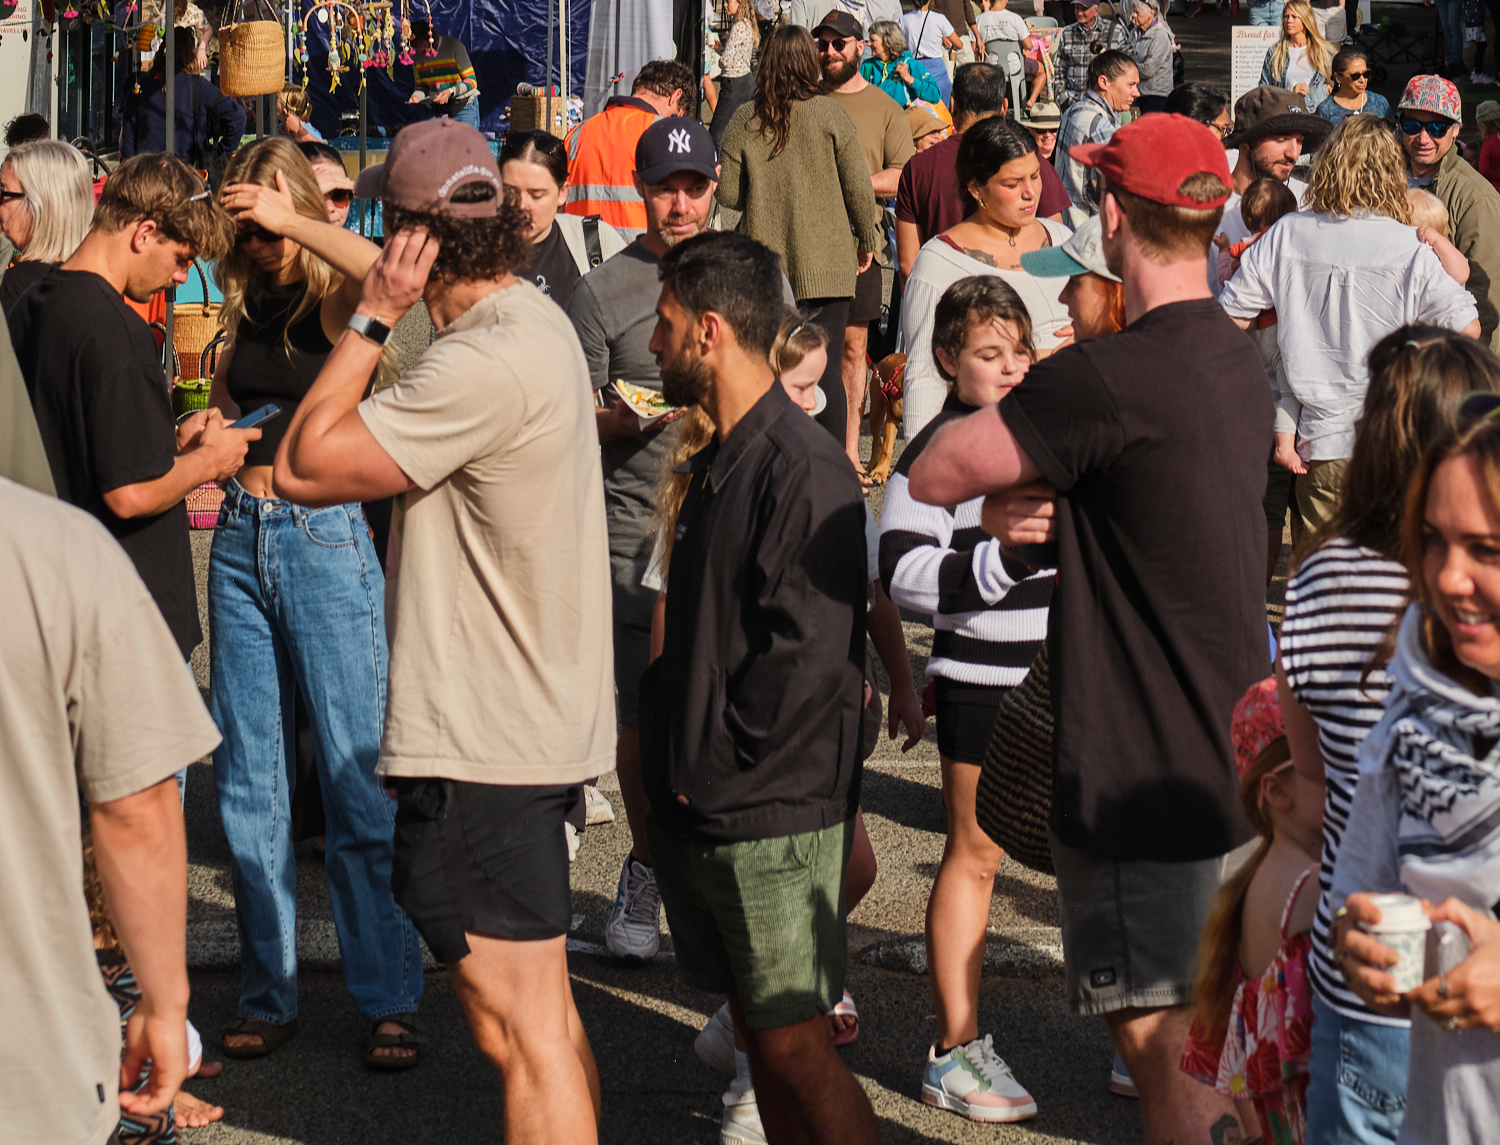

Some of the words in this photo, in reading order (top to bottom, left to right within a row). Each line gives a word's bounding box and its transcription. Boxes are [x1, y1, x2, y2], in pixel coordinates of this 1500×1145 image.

[1236, 30, 1262, 39] Bread
[1263, 30, 1276, 41] for
[668, 128, 691, 153] NY
